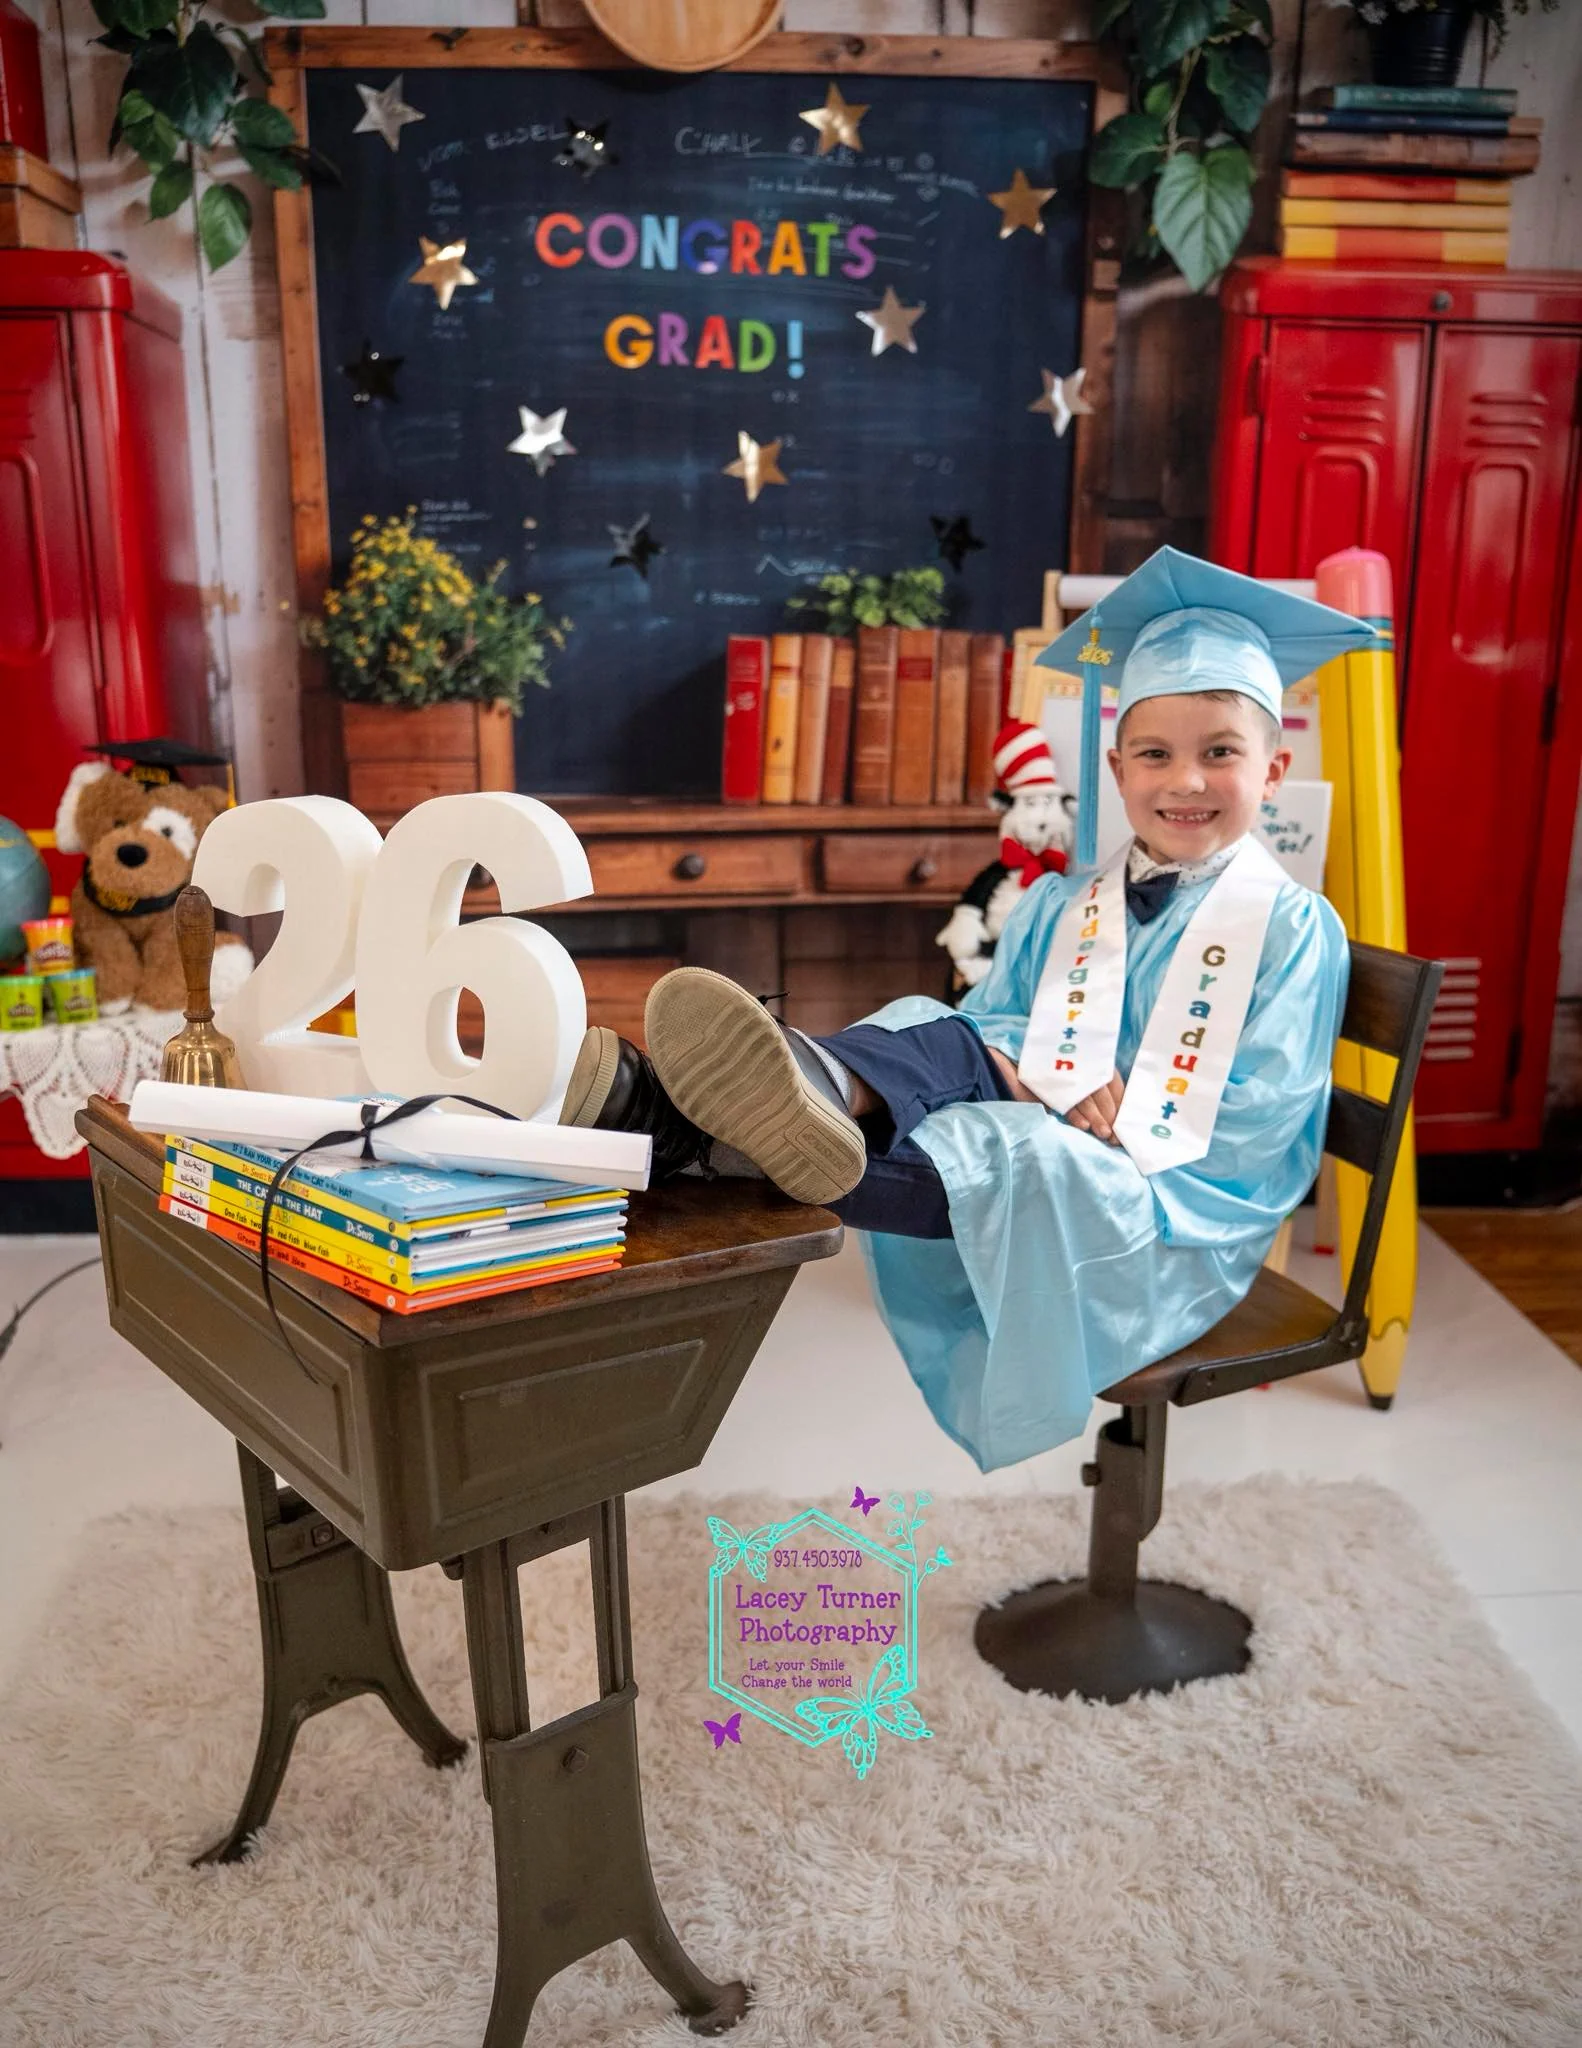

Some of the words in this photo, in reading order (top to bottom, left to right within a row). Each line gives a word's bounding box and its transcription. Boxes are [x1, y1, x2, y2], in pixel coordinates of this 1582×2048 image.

[535, 212, 877, 280] CONGRATS
[604, 312, 805, 380] GRAD!
[190, 791, 595, 1125] 26
[1151, 945, 1226, 1140] Graduate
[237, 1179, 252, 1193] THE
[286, 1198, 302, 1213] THE
[303, 1205, 323, 1221] HAT
